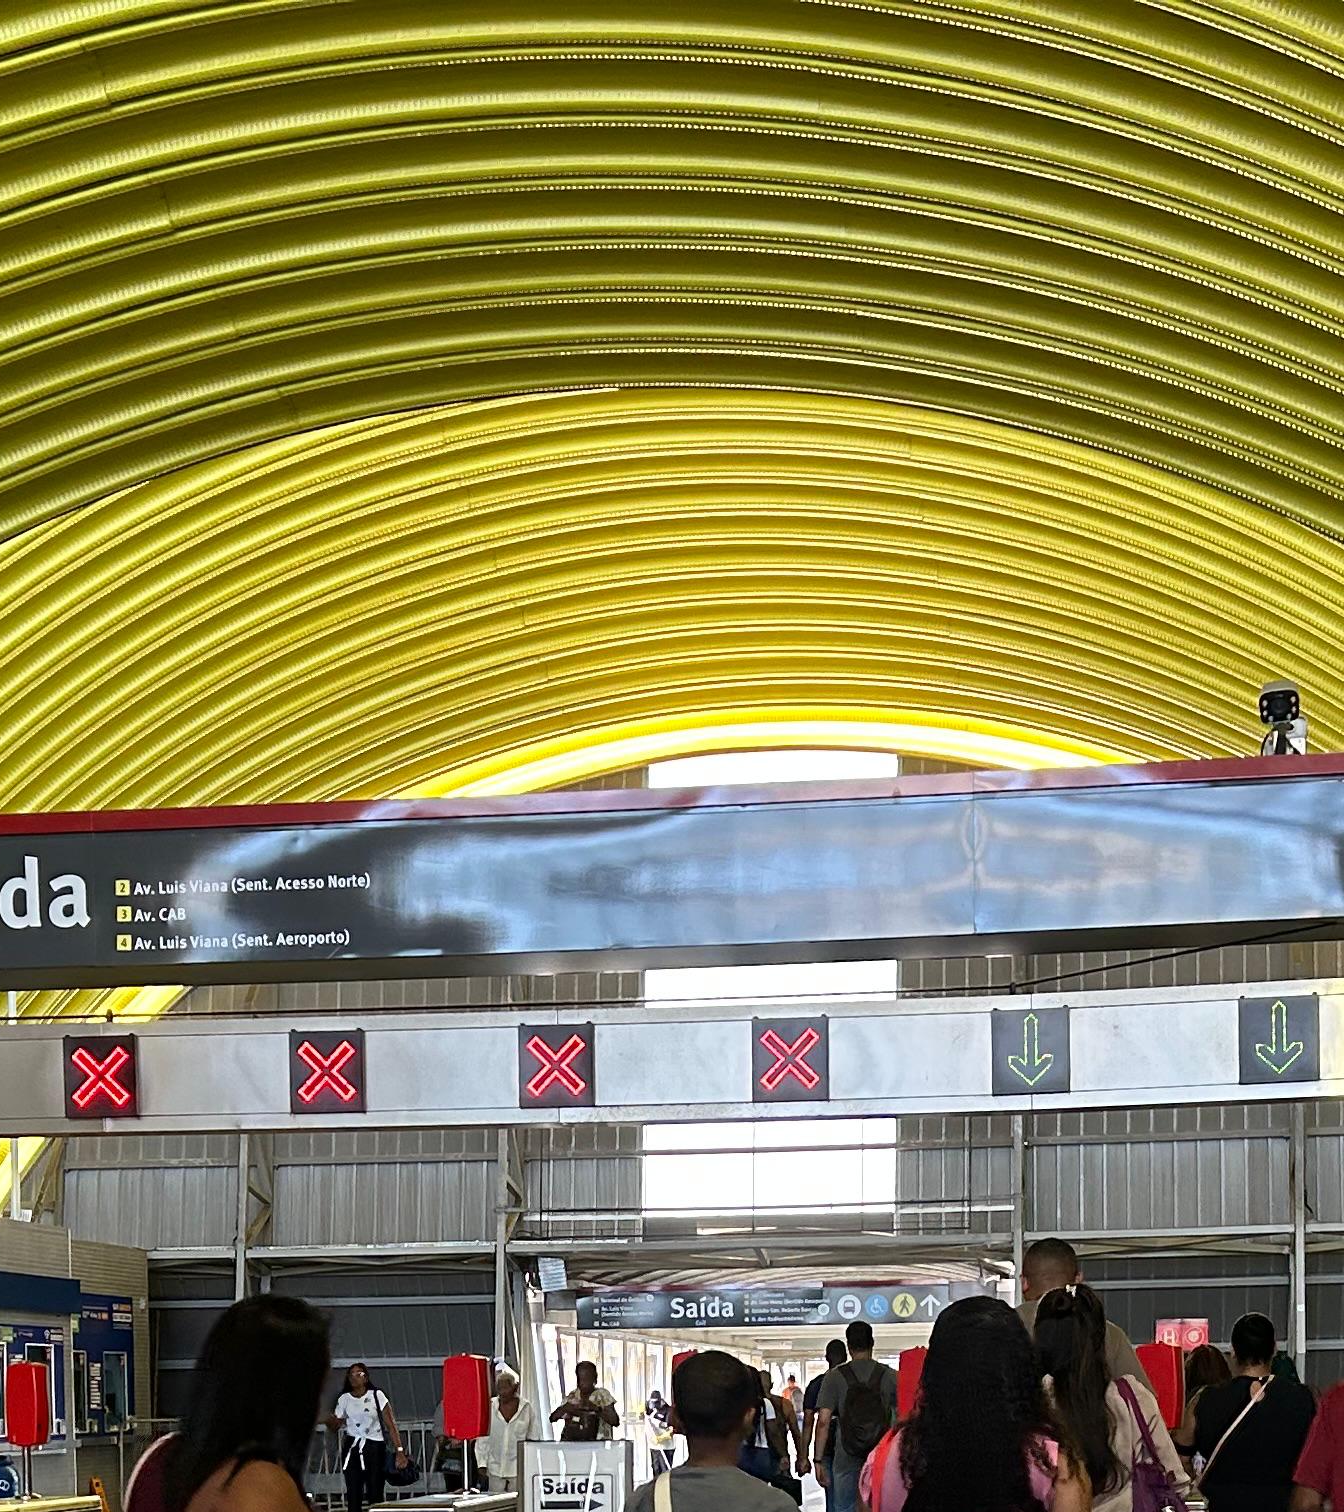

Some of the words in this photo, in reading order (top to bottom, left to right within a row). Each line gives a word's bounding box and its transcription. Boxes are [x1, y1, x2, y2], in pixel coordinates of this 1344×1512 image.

[134, 882, 155, 895] Av.
[159, 880, 186, 894] Luis
[189, 879, 228, 893] Viana
[231, 877, 272, 894] (Sent.
[276, 876, 324, 891] Acesso
[328, 872, 370, 889] Norte)
[134, 909, 156, 922] Av.
[159, 907, 186, 921] CAB
[135, 936, 156, 950] Av.
[159, 936, 187, 949] Luis
[190, 934, 229, 948] Viana
[232, 932, 273, 949] (Sent.
[276, 928, 350, 947] Aeroporto)
[670, 1295, 735, 1319] Saída
[542, 1478, 605, 1495] Saída
